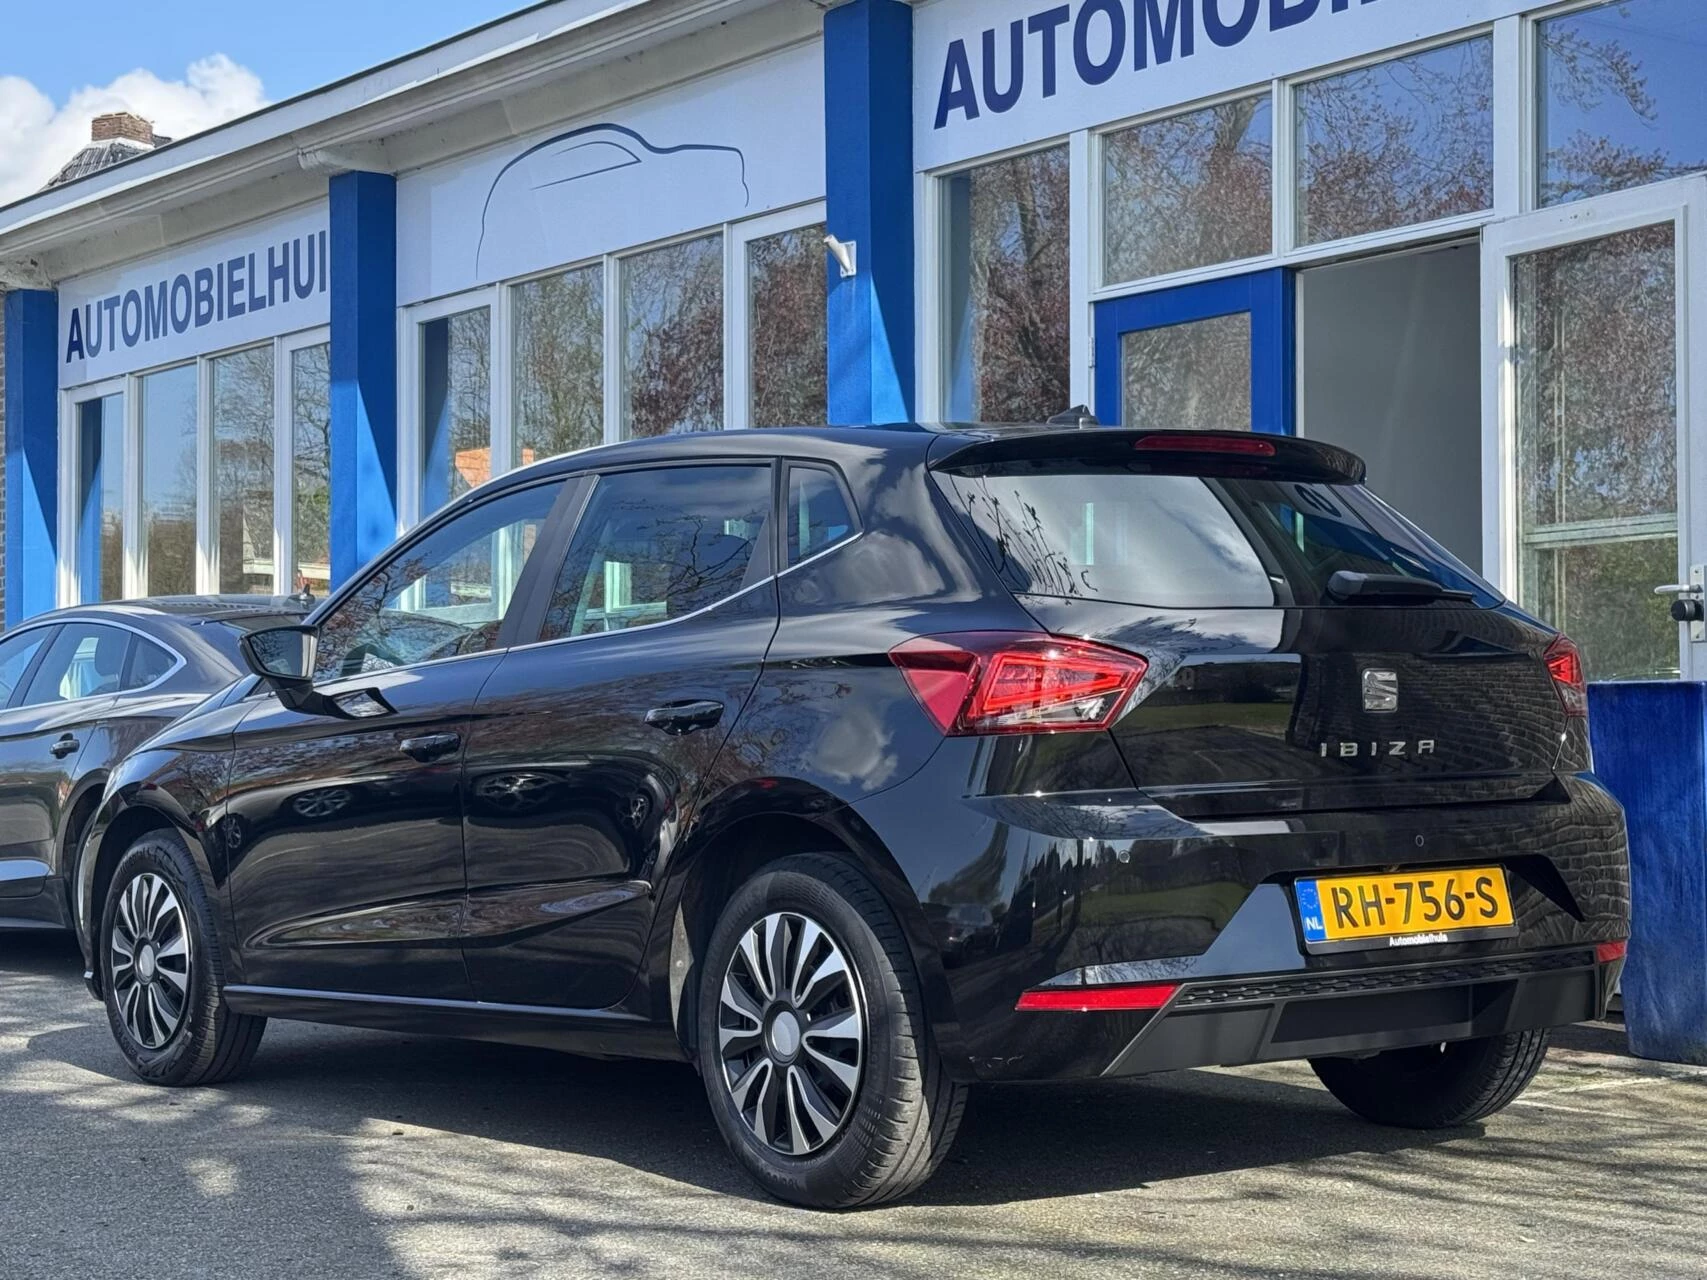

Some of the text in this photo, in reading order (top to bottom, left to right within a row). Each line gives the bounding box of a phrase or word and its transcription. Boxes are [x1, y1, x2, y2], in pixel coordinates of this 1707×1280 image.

[933, 0, 1379, 130] AUTOM
[66, 230, 327, 364] AUTOMOBIELHUI
[1320, 739, 1435, 757] IBIZA
[1305, 916, 1324, 931] NL
[1331, 876, 1499, 929] RH-756-S
